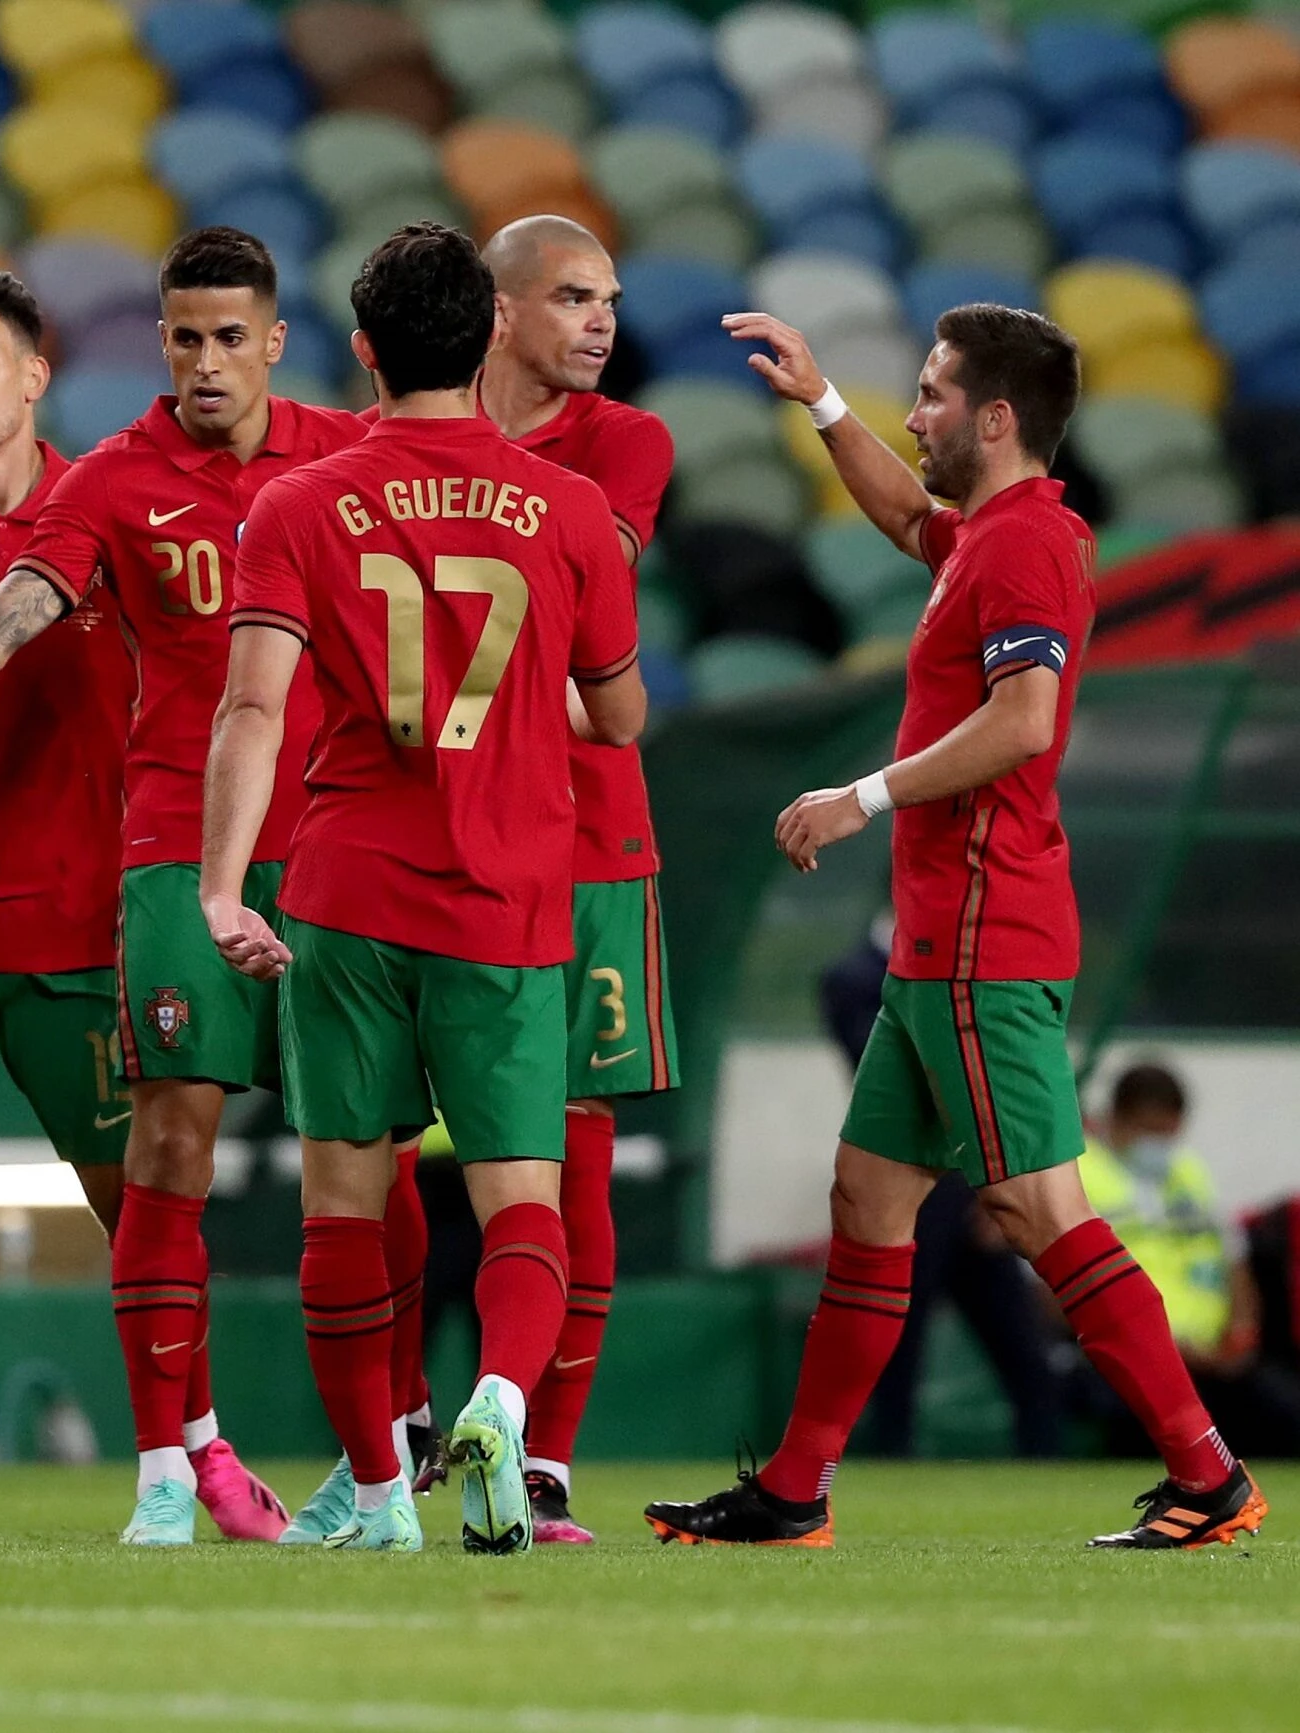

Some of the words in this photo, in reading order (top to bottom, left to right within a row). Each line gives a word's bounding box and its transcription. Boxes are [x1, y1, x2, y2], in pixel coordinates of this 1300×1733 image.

[335, 493, 383, 538] G.
[383, 476, 549, 539] GUEDES
[150, 538, 224, 617] 20
[359, 552, 530, 751] 17
[589, 967, 627, 1041] 3
